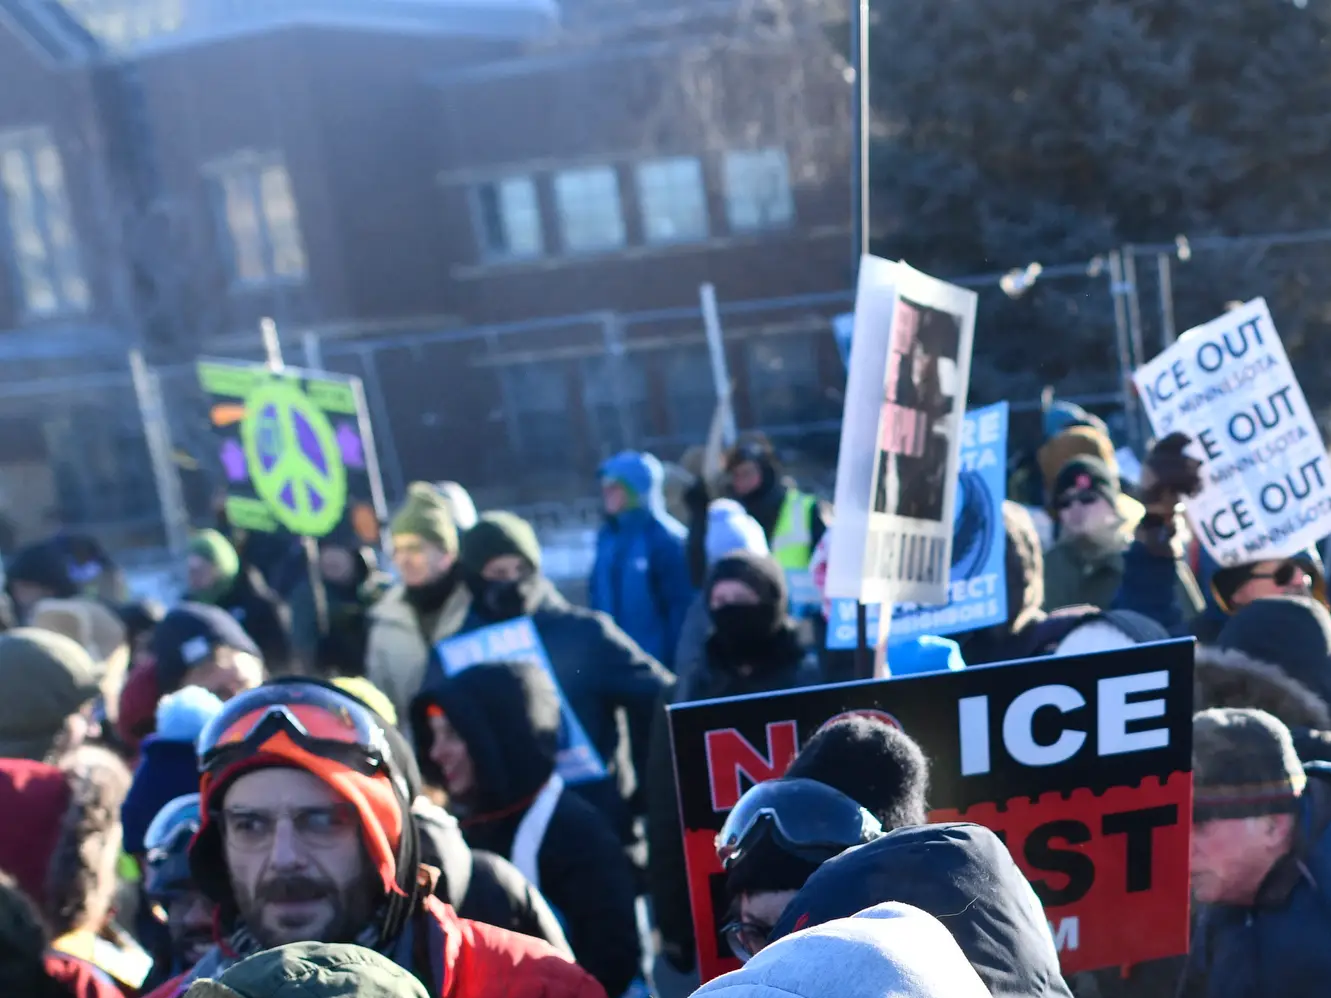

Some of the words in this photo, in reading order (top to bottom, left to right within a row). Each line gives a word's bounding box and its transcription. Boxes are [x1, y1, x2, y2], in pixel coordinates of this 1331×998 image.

[1144, 359, 1191, 411] ICE
[1196, 315, 1265, 373] OUT
[1228, 385, 1296, 443] OUT
[1200, 498, 1253, 547] ICE
[1260, 457, 1326, 514] OUT
[958, 669, 1170, 777] ICE
